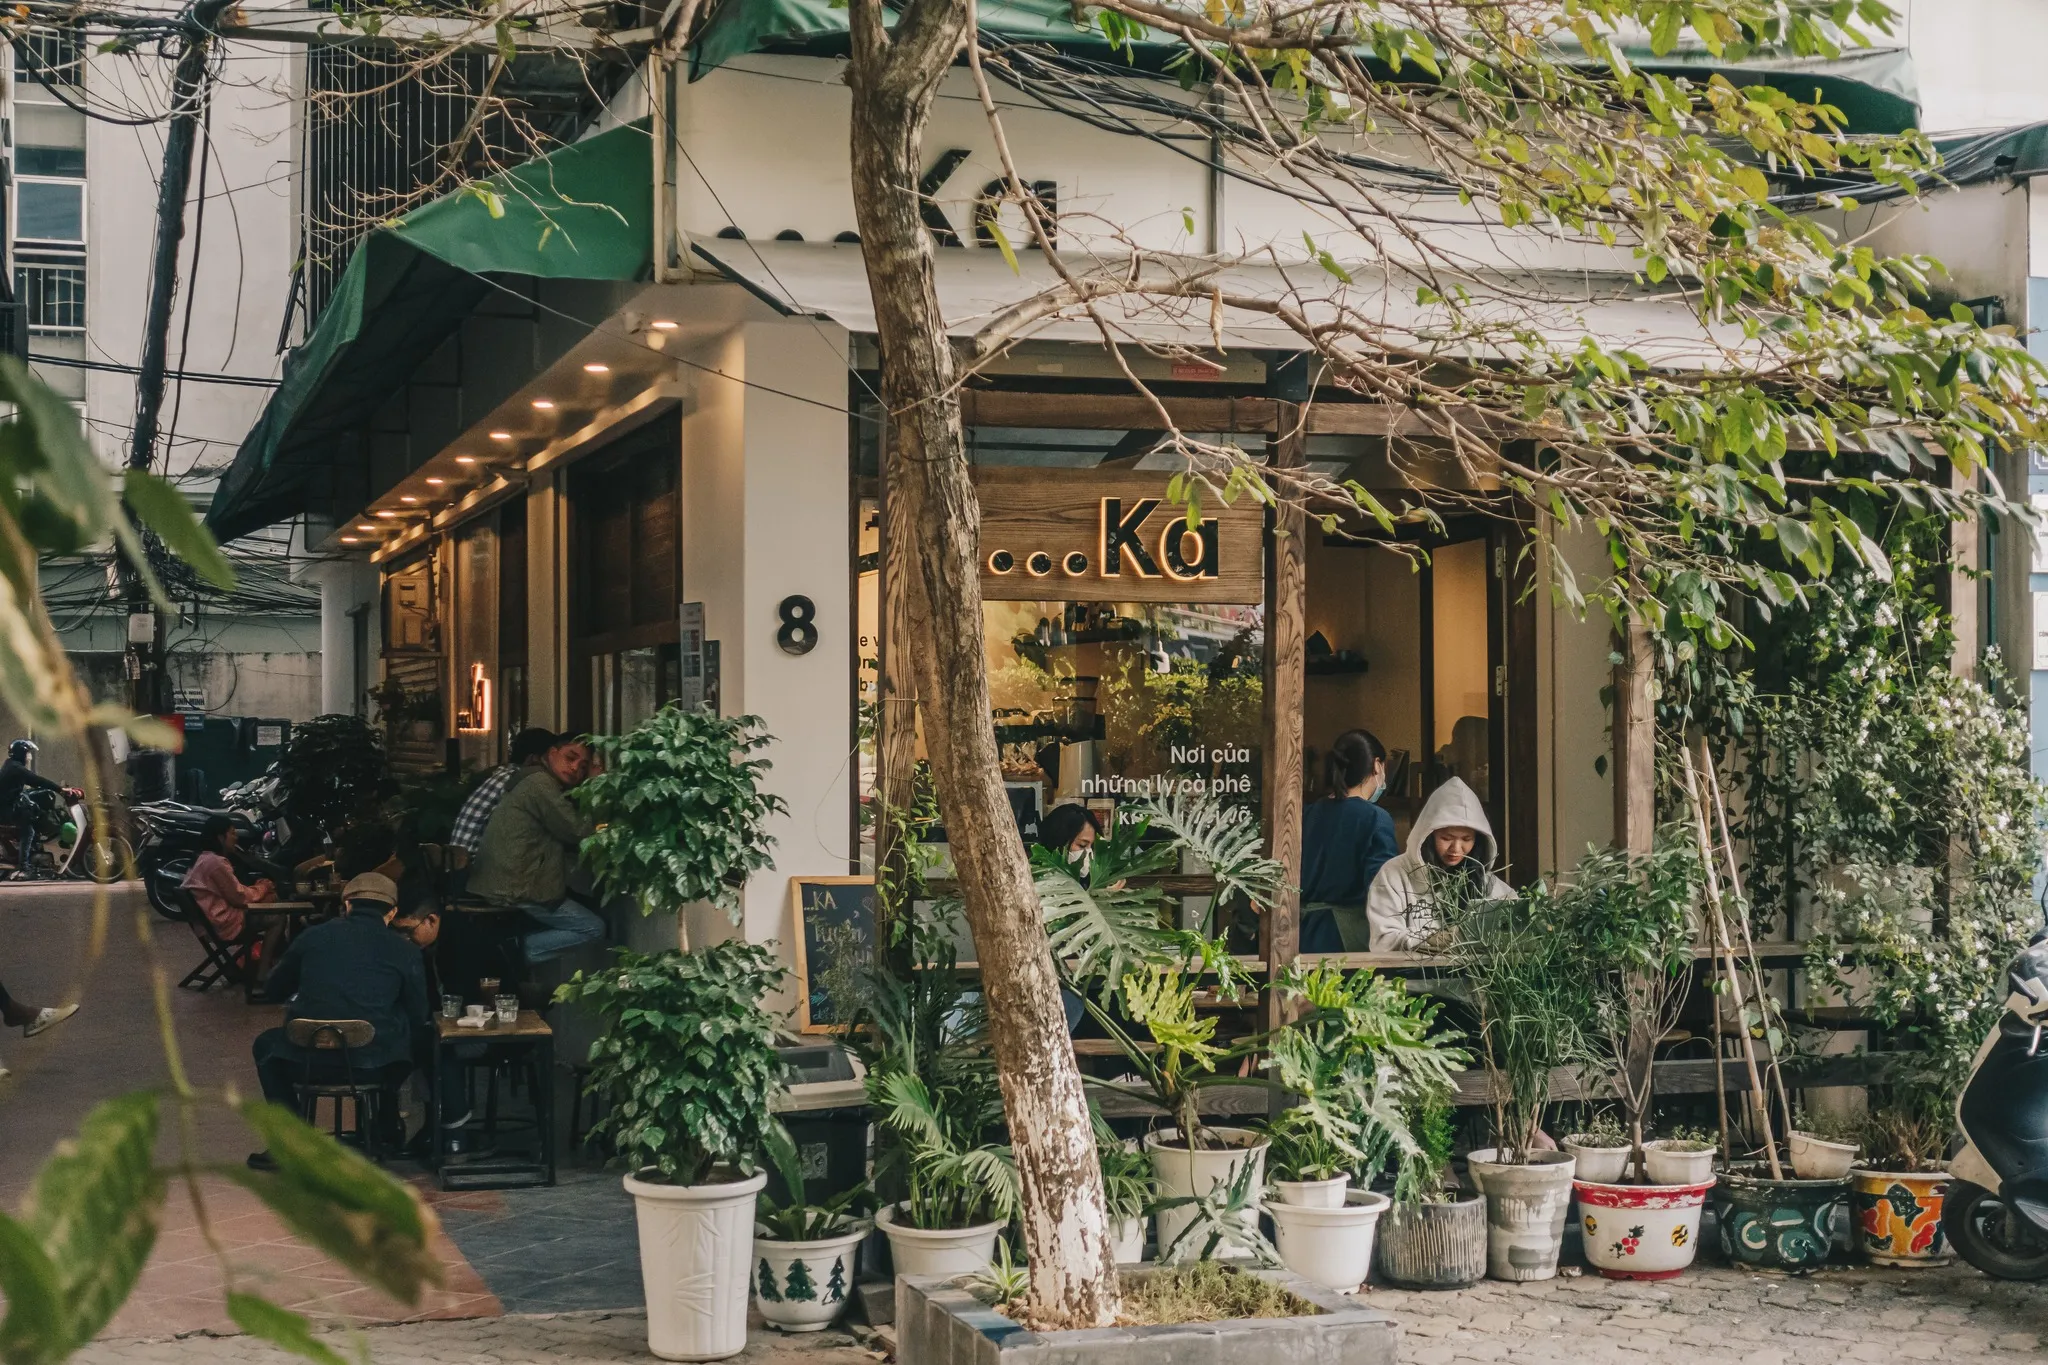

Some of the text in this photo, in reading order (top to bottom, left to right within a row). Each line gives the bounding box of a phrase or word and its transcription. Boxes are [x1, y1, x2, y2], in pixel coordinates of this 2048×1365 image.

[777, 594, 818, 655] 8
[1171, 743, 1250, 763] Nơi của
[1081, 774, 1150, 798] những
[1183, 773, 1206, 793] cà
[1213, 774, 1251, 797] phê
